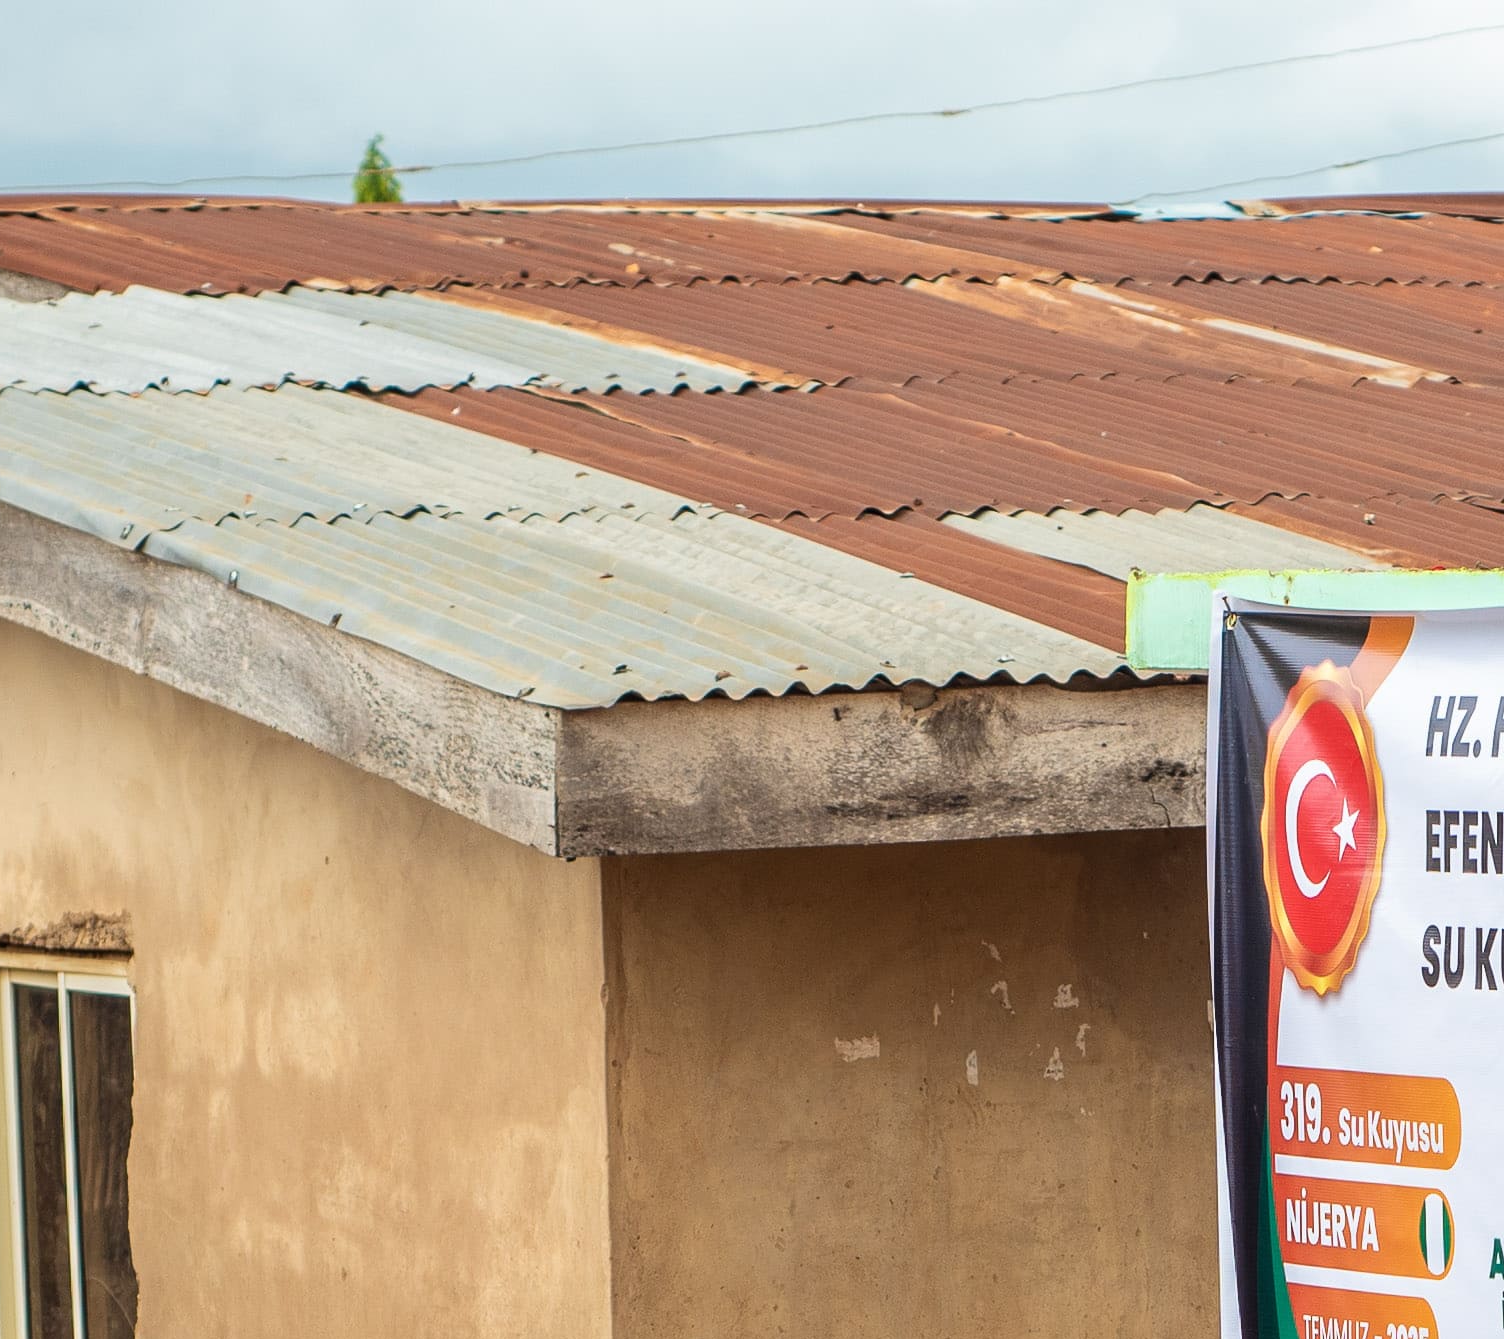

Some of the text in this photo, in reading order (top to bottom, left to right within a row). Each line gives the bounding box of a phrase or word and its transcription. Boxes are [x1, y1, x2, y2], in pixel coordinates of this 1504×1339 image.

[1426, 696, 1481, 758] HZ.
[1421, 925, 1465, 989] SU
[1280, 1081, 1443, 1163] 319. Su Kuyusu
[1286, 1188, 1379, 1251] NİJERYA
